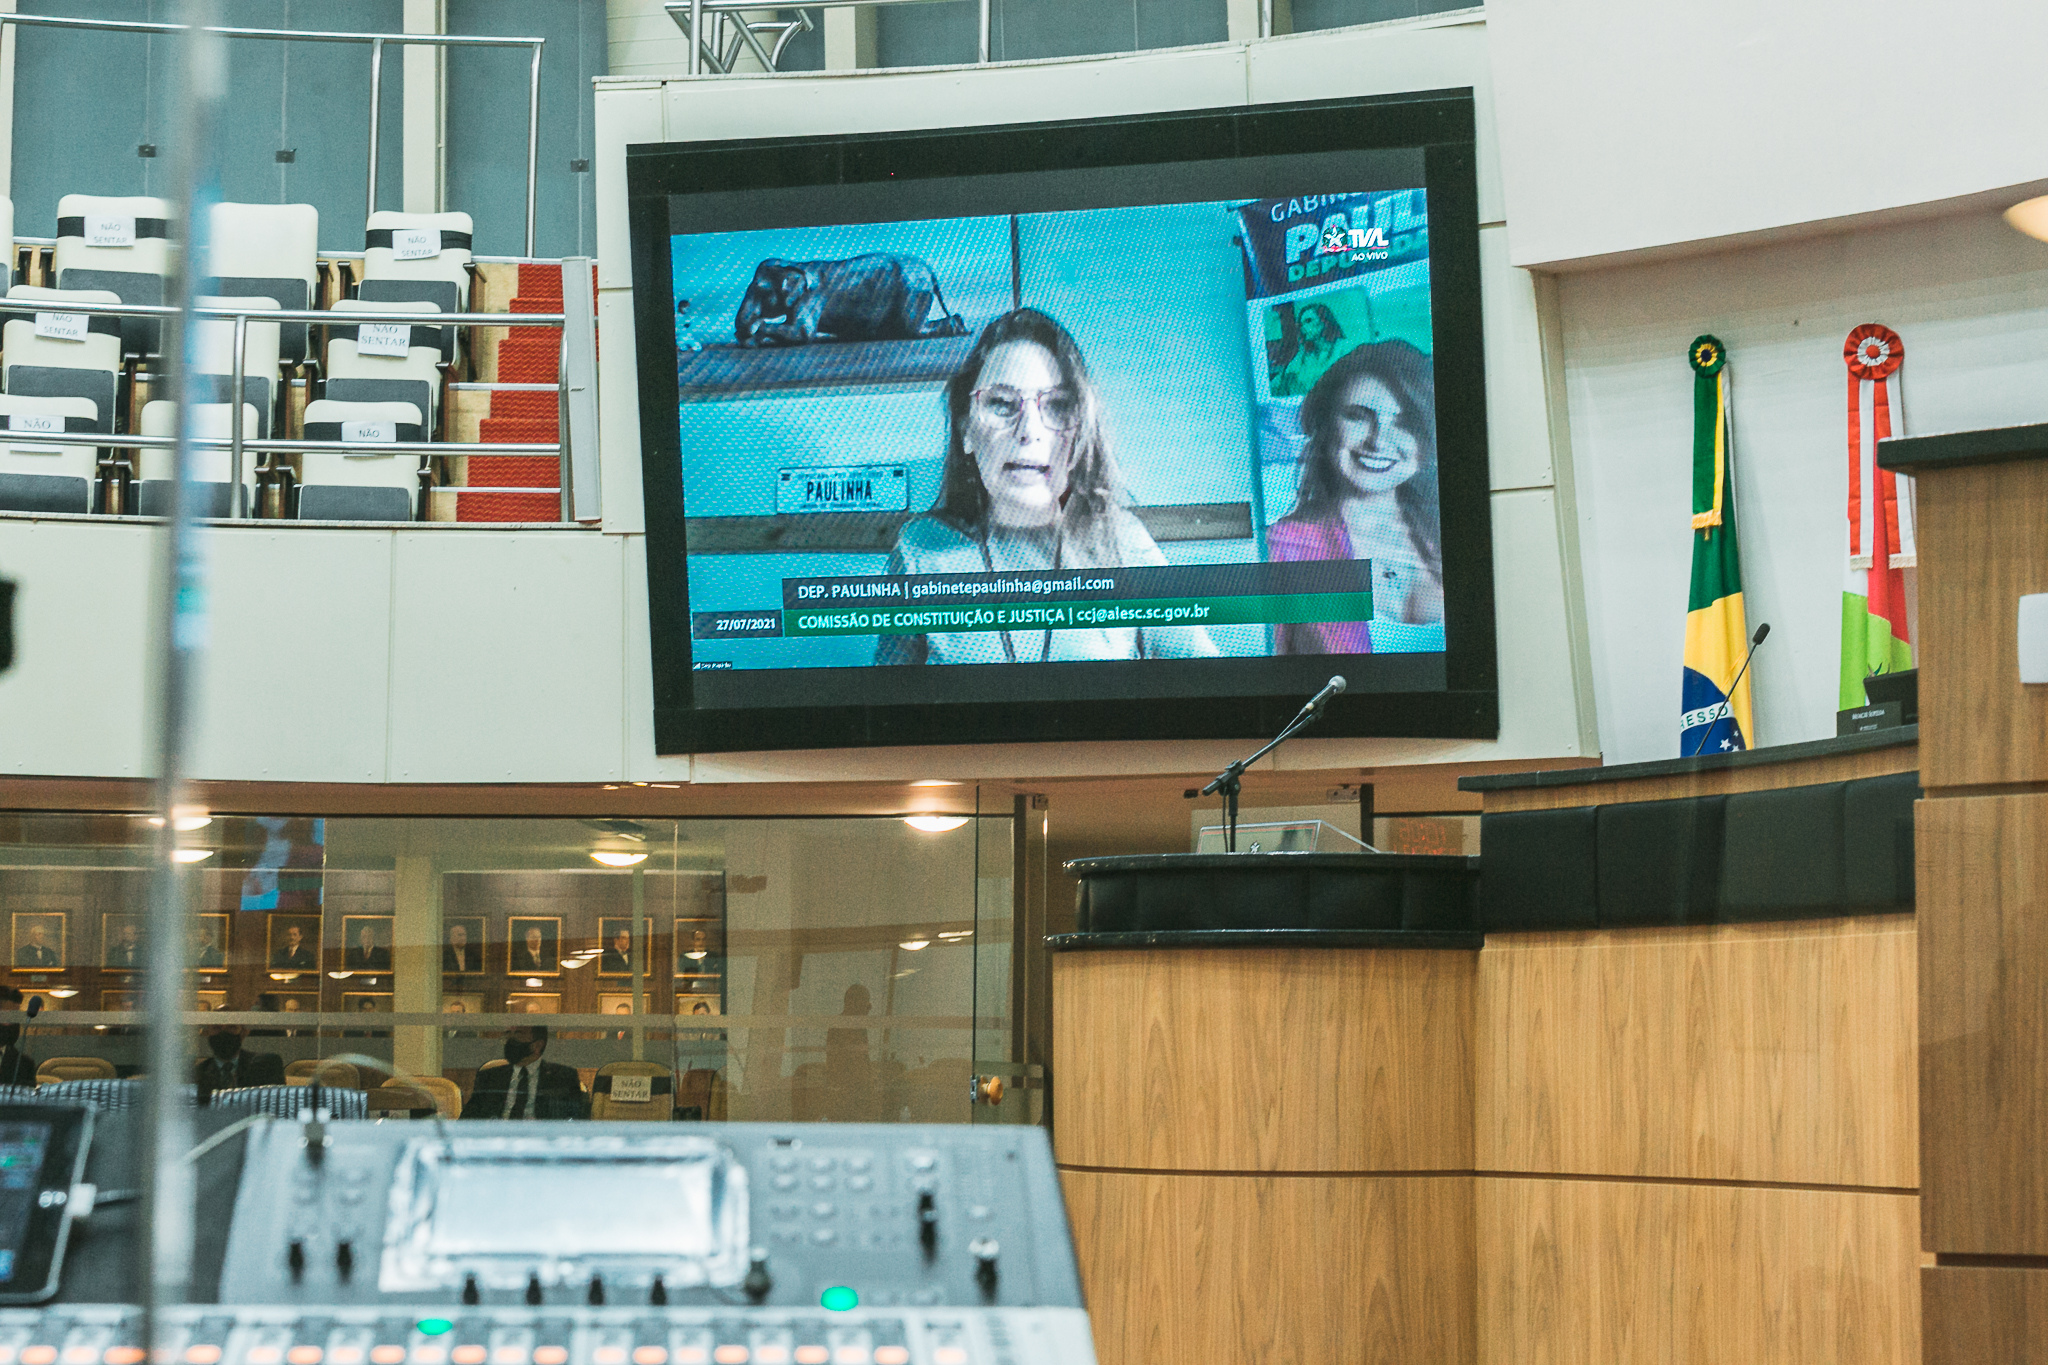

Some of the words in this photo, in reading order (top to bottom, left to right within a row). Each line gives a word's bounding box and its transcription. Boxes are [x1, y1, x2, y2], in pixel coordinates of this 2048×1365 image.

[101, 223, 121, 231] NÃO
[93, 236, 128, 244] SENTAR
[408, 236, 427, 244] NÃO
[401, 249, 433, 257] SENTAR
[1350, 252, 1366, 262] AO
[1366, 251, 1389, 261] VIVO
[44, 325, 79, 337] SENTAR
[361, 335, 407, 347] SENTAR
[24, 418, 51, 430] NÃO
[359, 428, 380, 438] NÃO
[806, 480, 873, 502] PAULINHA
[798, 584, 829, 599] DEP.
[831, 582, 901, 598] PAULINHA
[912, 576, 1115, 599] gabinetepaulinha@gmail.com
[798, 612, 869, 629] COMISSÃO
[872, 613, 891, 627] DE
[893, 608, 995, 628] CONSTITUIÇÃO
[997, 610, 1006, 624] E
[1008, 607, 1066, 625] JUSTIÇA
[1076, 603, 1210, 624] ccj@alesc.sc.gov.br
[716, 617, 776, 632] 27/07/2021
